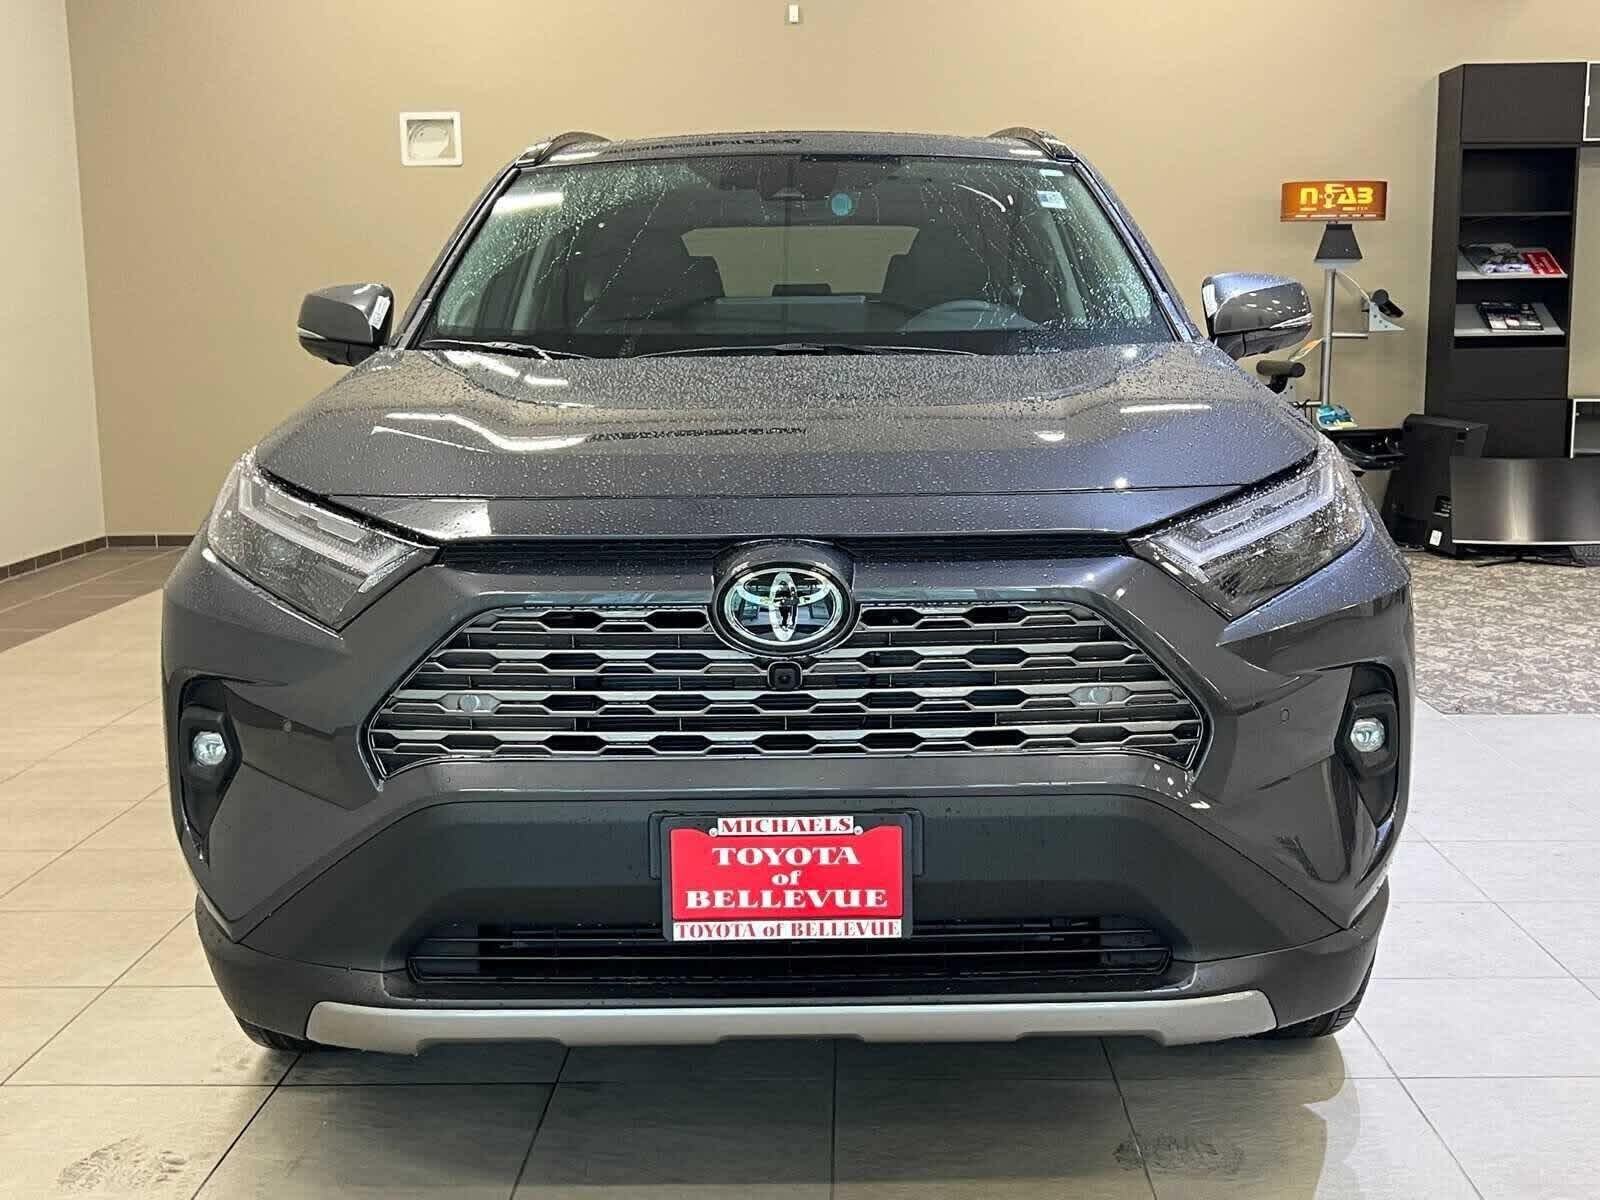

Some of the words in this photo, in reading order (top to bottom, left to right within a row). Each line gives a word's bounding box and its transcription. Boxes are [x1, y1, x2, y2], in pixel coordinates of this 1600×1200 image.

[721, 817, 852, 833] MICHAELS
[712, 847, 861, 866] TOYOTA
[771, 870, 803, 886] of
[686, 889, 888, 909] BELLEVUE
[675, 923, 755, 938] TOYOTA
[763, 922, 784, 937] of
[791, 921, 900, 937] BELLEVUE
